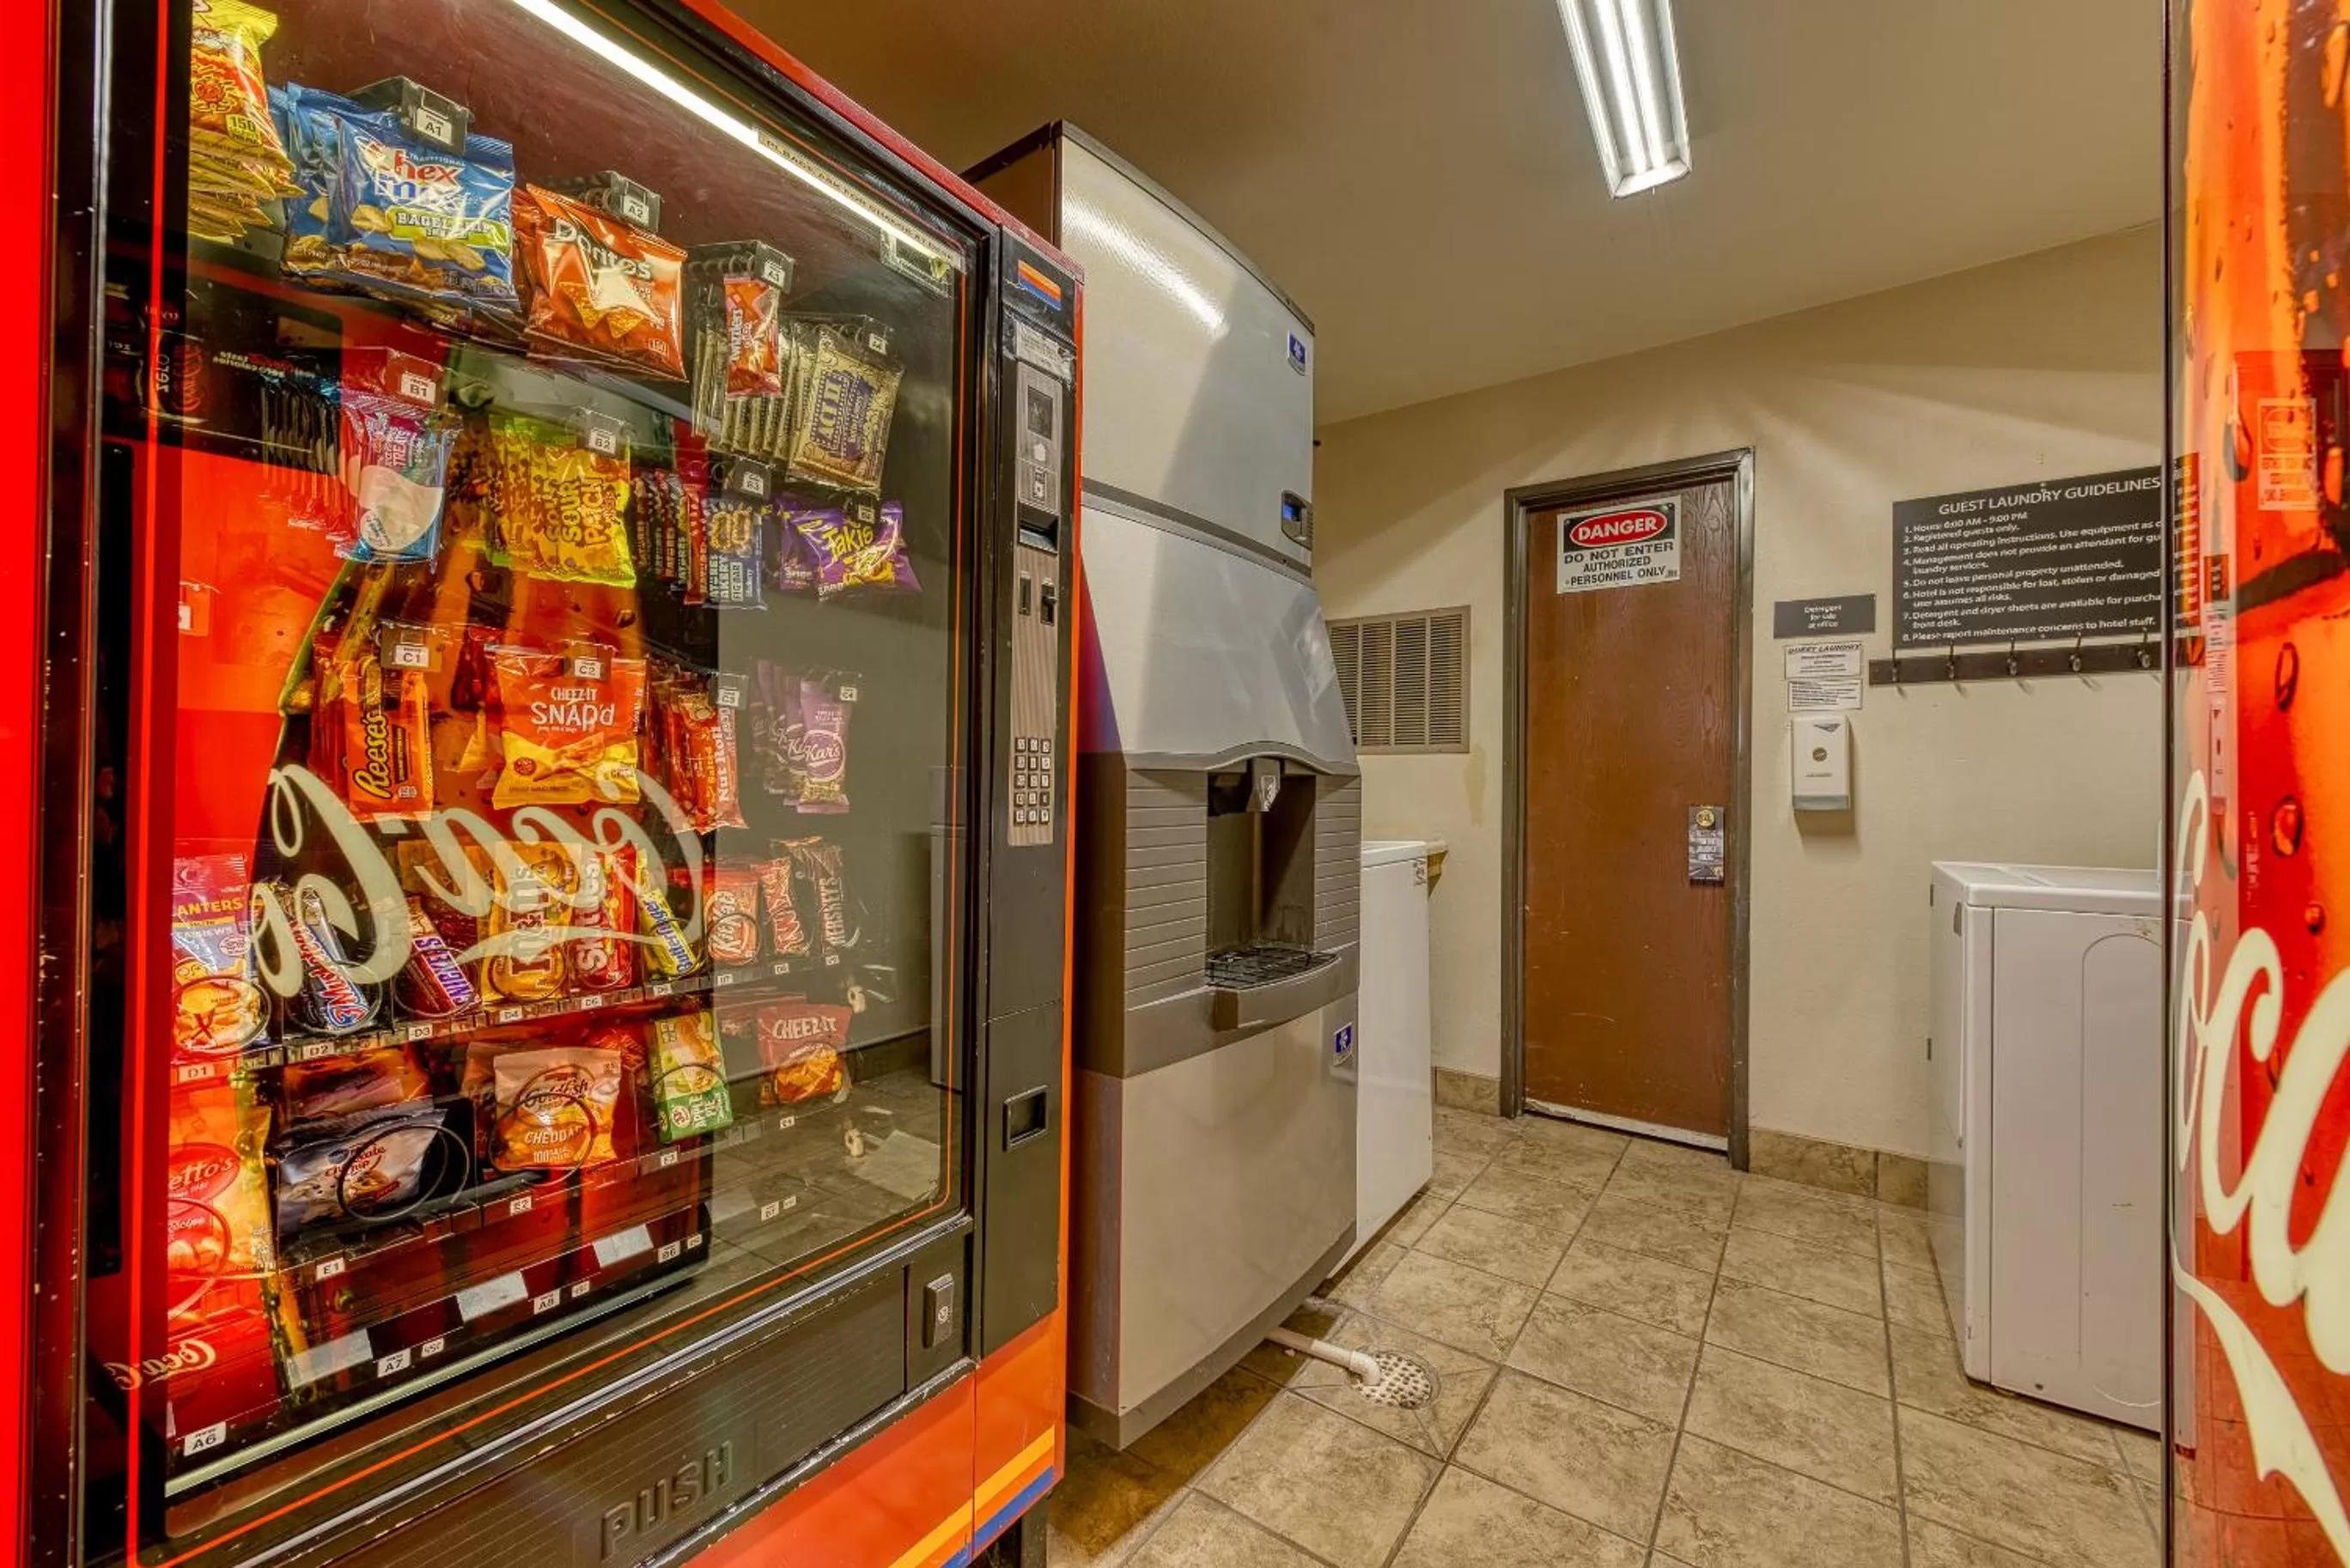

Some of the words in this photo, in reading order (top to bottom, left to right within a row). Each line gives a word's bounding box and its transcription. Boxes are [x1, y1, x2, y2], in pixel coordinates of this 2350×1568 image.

[425, 122, 441, 137] A1
[629, 206, 643, 216] A2
[410, 383, 428, 398] B1
[594, 436, 611, 449] B2
[1939, 499, 1986, 514] GUEST
[1988, 489, 2061, 509] LAUNDRY
[2065, 477, 2161, 499] GUIDELINES
[1966, 517, 1982, 526] AM
[2011, 510, 2028, 520] PM
[1578, 516, 1659, 541] DANGER
[1913, 529, 1962, 542] Registered
[1963, 526, 1994, 538] guests
[1995, 523, 2019, 533] only.
[1937, 542, 1948, 550] all
[1950, 538, 1996, 550] operating
[1997, 531, 2058, 544] instructions.
[2060, 530, 2079, 538] Use
[2080, 522, 2140, 537] equipment
[1564, 553, 1585, 564] DO
[1590, 549, 1619, 560] NOT
[1625, 541, 1674, 556] ENTER
[1913, 553, 1974, 565] Management
[2018, 544, 2057, 556] provide
[2074, 537, 2127, 549] attendant
[2128, 535, 2143, 544] for
[1583, 556, 1651, 572] AUTHORIZED
[1914, 565, 1948, 574] laundry
[1972, 570, 2013, 582] personal
[2015, 567, 2058, 579] property
[2060, 559, 2124, 573] unattended.
[1571, 570, 1634, 586] PERSONNEL
[1638, 566, 1666, 578] ONLY
[1913, 589, 1937, 598] Hotel
[1966, 582, 2021, 593] responsible
[2061, 576, 2093, 585] stolen
[2110, 568, 2161, 581] damaged
[1913, 609, 1958, 619] Detergent
[1961, 607, 1979, 616] and
[1980, 606, 2006, 615] dryer
[2007, 603, 2038, 612] sheets
[2059, 598, 2104, 609] available
[2124, 593, 2161, 605] purcha
[1942, 630, 1972, 640] report
[1974, 625, 2036, 636] maintenance
[2038, 623, 2085, 632] concerns
[2099, 618, 2127, 629] hotel
[2129, 617, 2155, 626] staff.
[403, 653, 421, 663] C1
[579, 665, 595, 675] C2
[176, 896, 244, 916] ANTERS
[414, 1027, 430, 1037] D3
[309, 1044, 329, 1055] D2
[187, 1067, 208, 1079] D1
[168, 1158, 234, 1190] etto's
[322, 1261, 341, 1274] E1
[384, 1357, 403, 1371] A7
[191, 1433, 216, 1452] A6
[602, 1439, 734, 1559] PUSH
